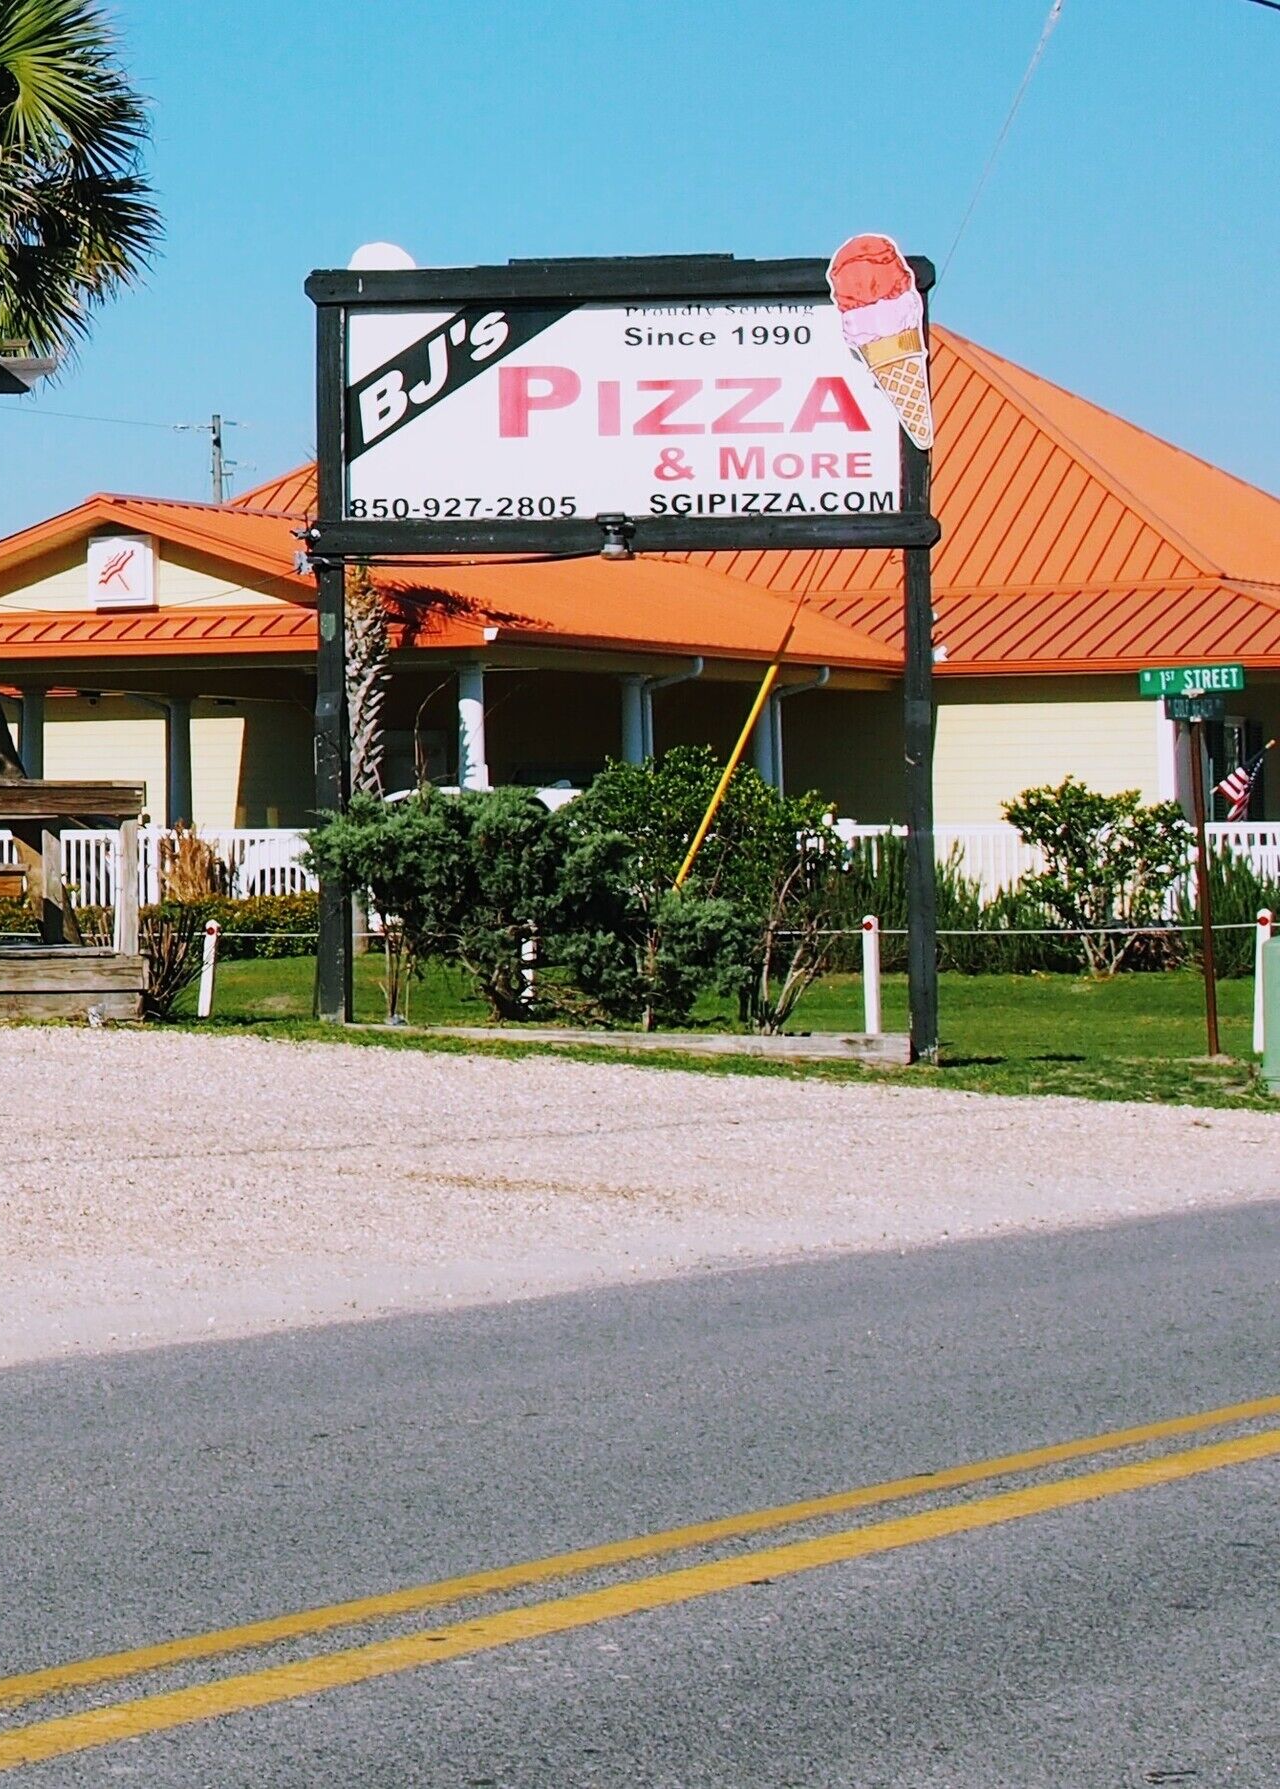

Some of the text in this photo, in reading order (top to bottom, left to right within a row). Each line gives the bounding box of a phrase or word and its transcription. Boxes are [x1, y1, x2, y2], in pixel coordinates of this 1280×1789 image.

[624, 325, 812, 346] Since 1990
[358, 311, 509, 445] BJ's
[498, 365, 872, 438] PIZZA
[653, 446, 873, 481] & MORE
[352, 496, 577, 518] 850-927-2805
[649, 491, 894, 515] SGIPIZZA.COM
[1183, 667, 1238, 689] STREET
